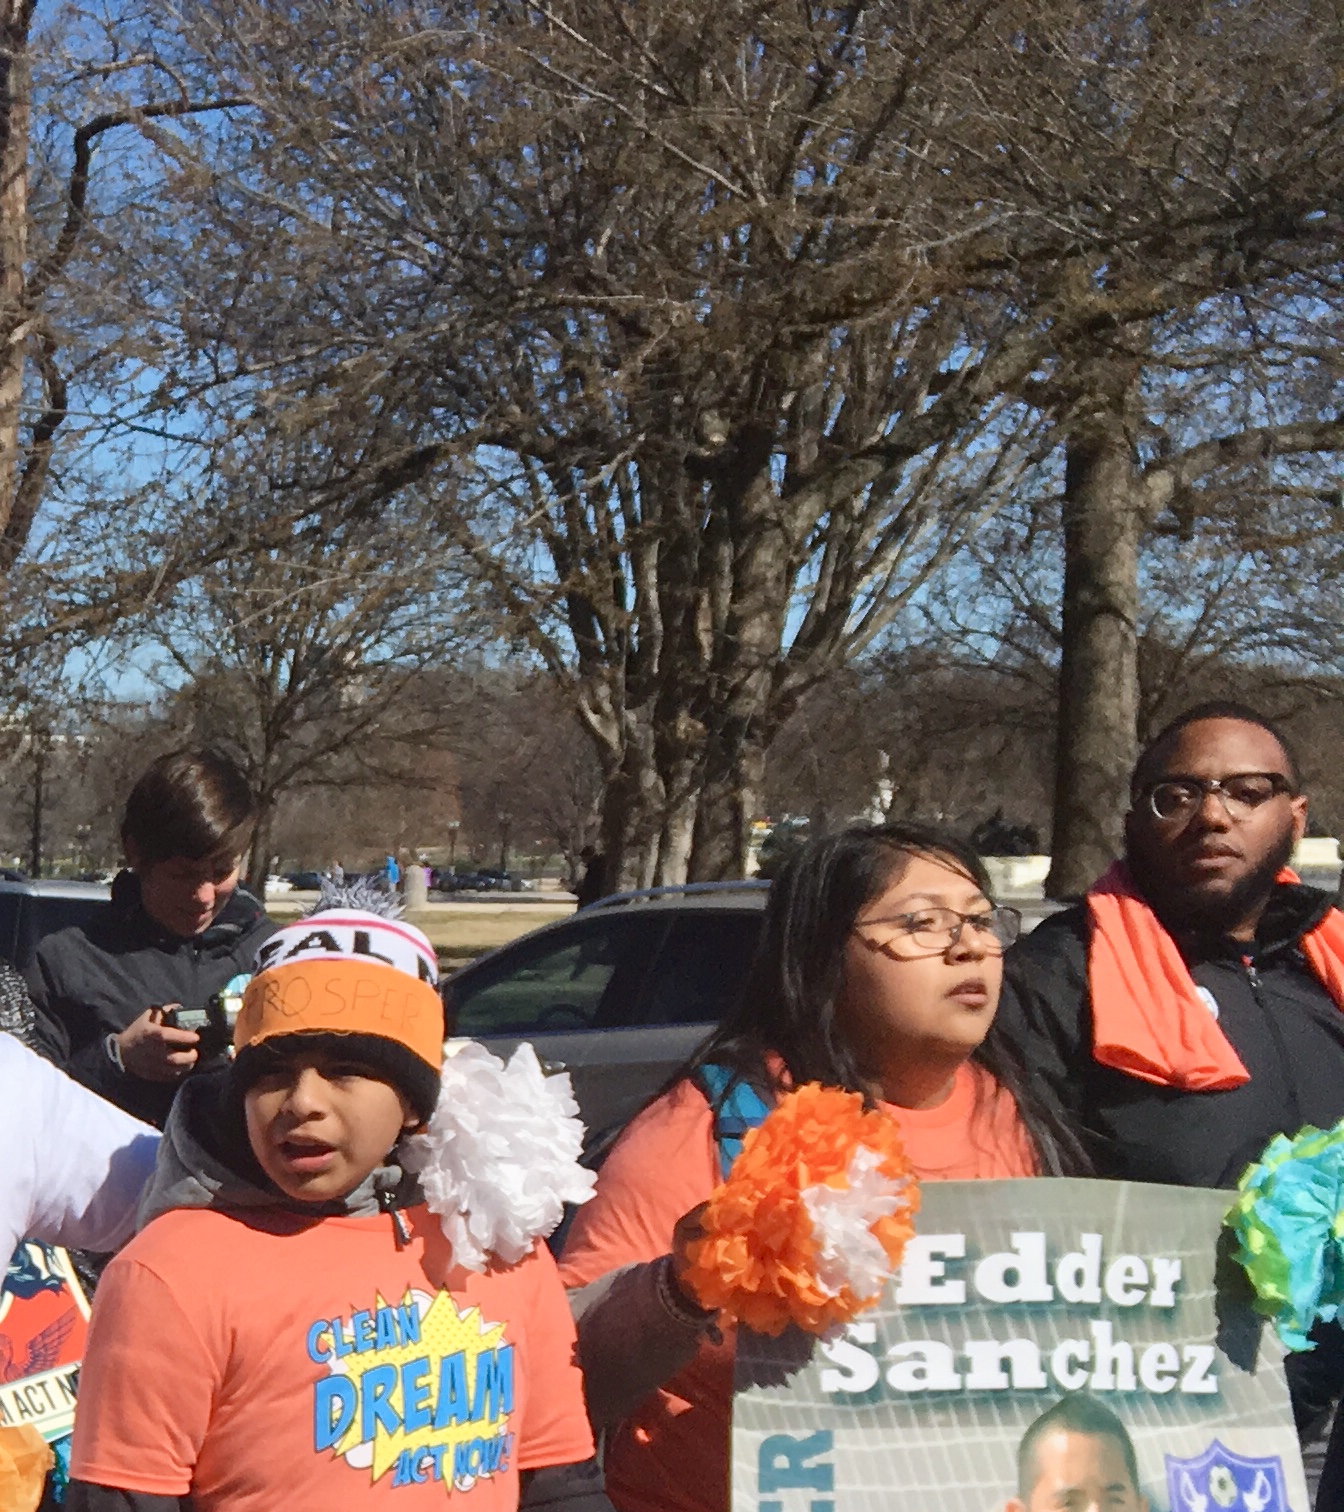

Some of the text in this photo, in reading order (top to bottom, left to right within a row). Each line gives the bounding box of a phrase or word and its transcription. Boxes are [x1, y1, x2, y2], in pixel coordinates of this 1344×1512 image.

[895, 1232, 1181, 1308] Edder
[307, 1301, 422, 1364] CLEAN
[818, 1320, 1218, 1392] Sanchez
[12, 1380, 57, 1420] ACT
[314, 1343, 515, 1452] DREAM
[391, 1431, 515, 1488] ACT NOW!
